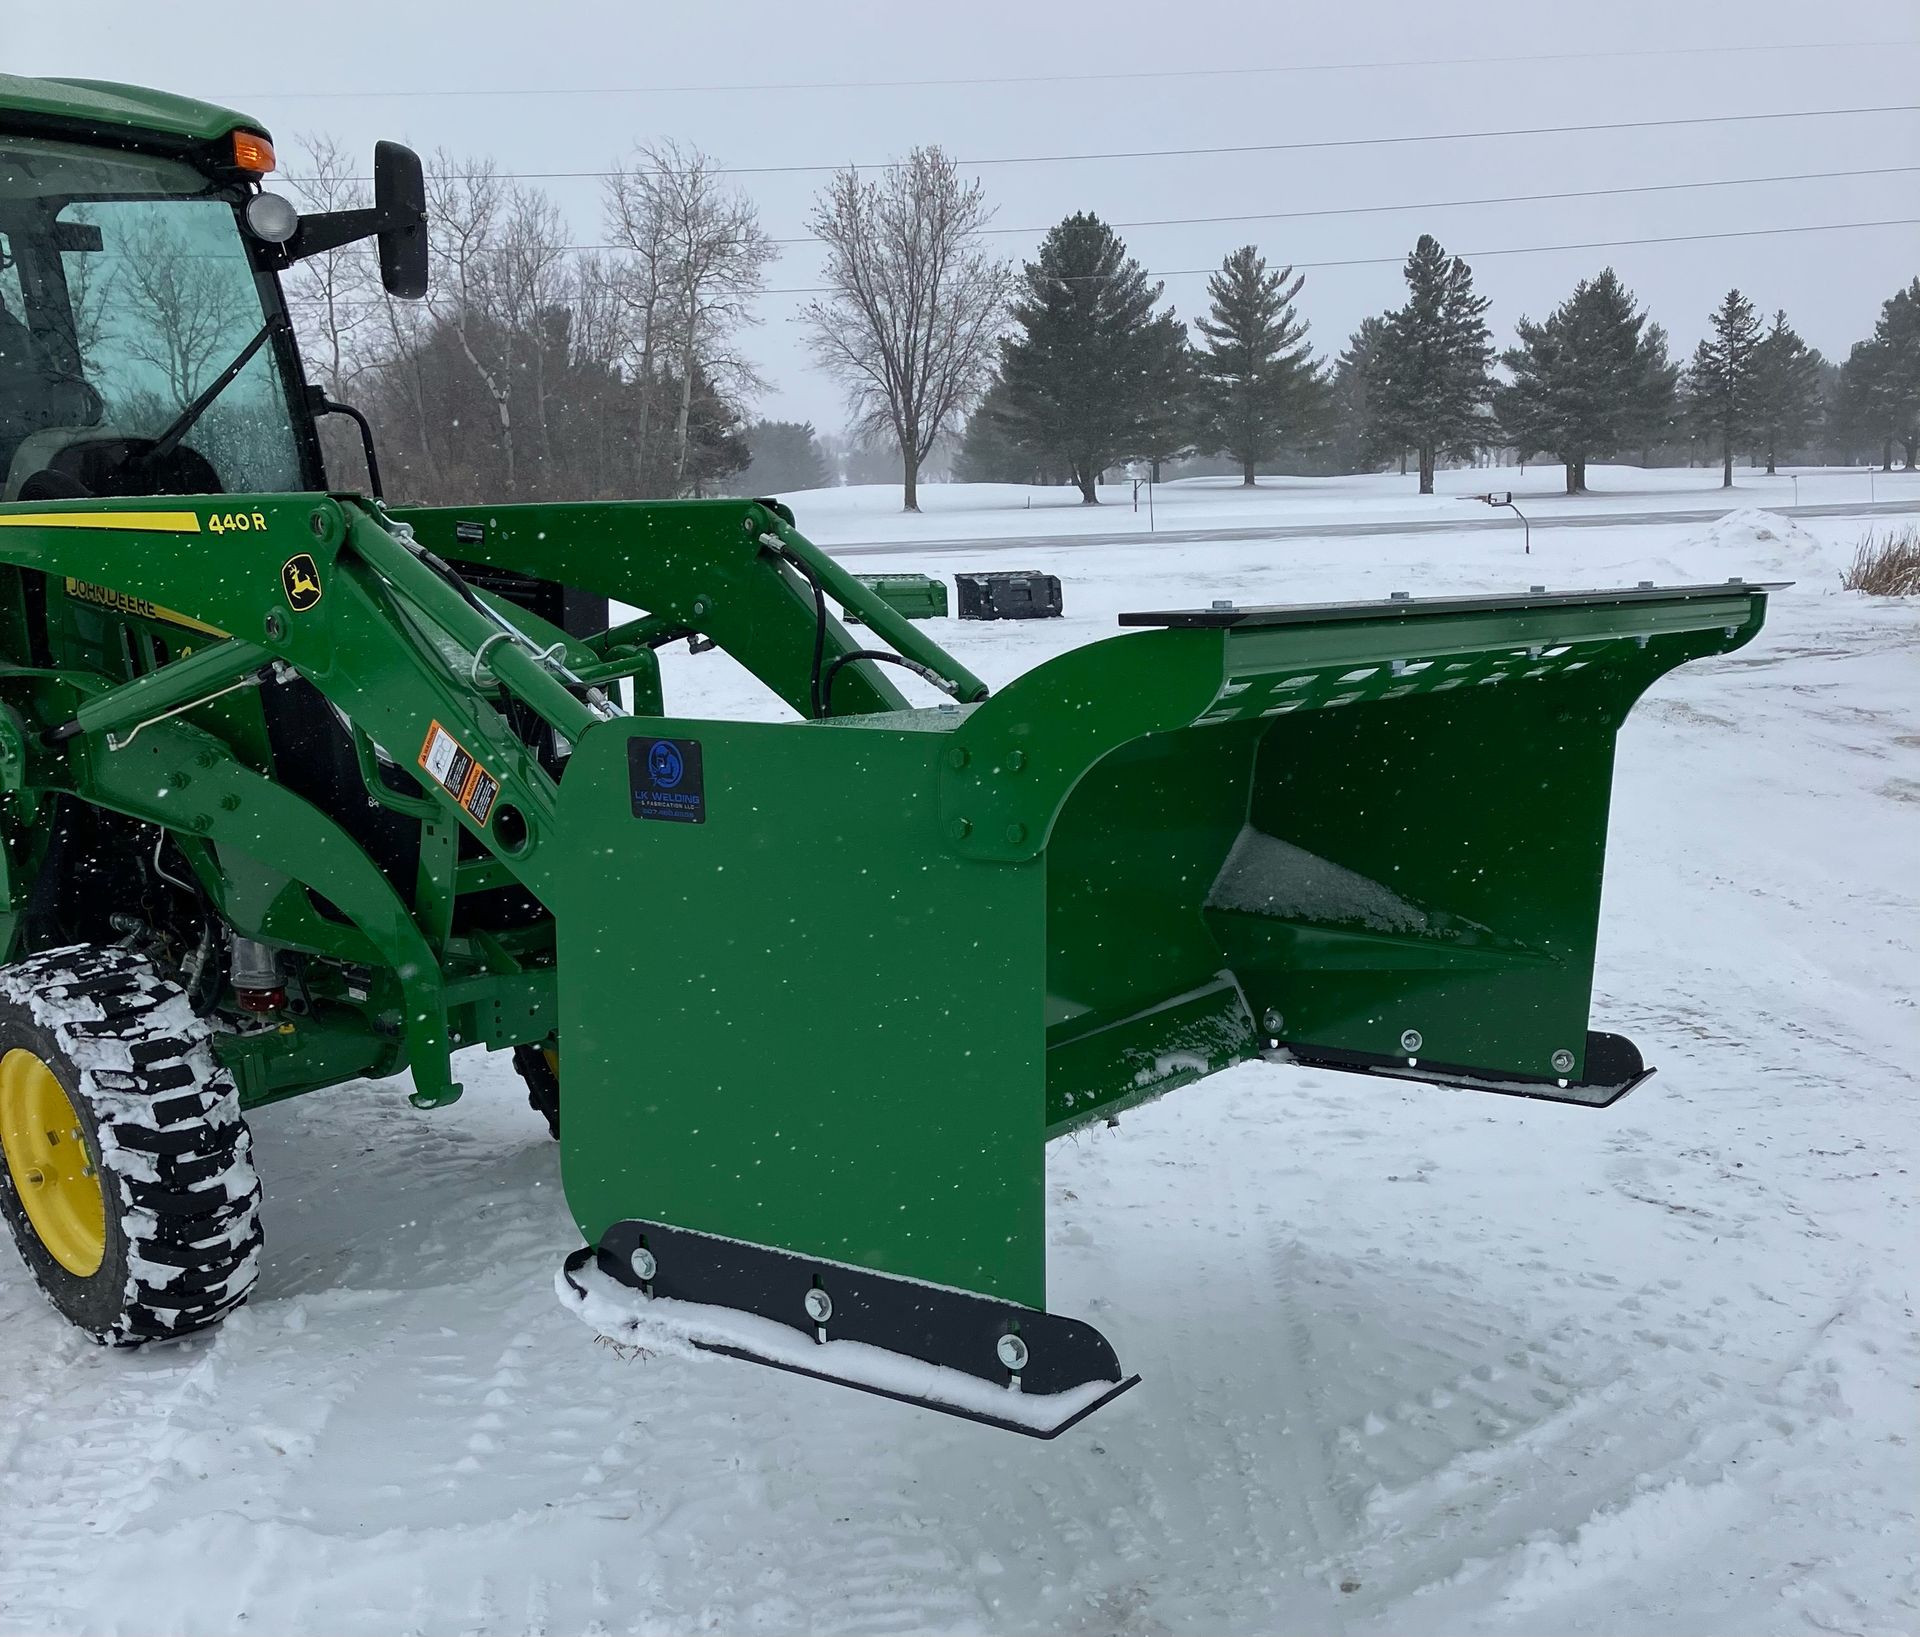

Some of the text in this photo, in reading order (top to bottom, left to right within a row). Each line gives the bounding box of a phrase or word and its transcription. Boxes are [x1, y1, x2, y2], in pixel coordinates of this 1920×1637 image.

[71, 578, 157, 617] JOHN DEERE
[425, 726, 437, 754] WARNING
[468, 769, 480, 798] WARNING
[635, 791, 700, 804] LK WELDING
[646, 801, 683, 809] FABRICATION
